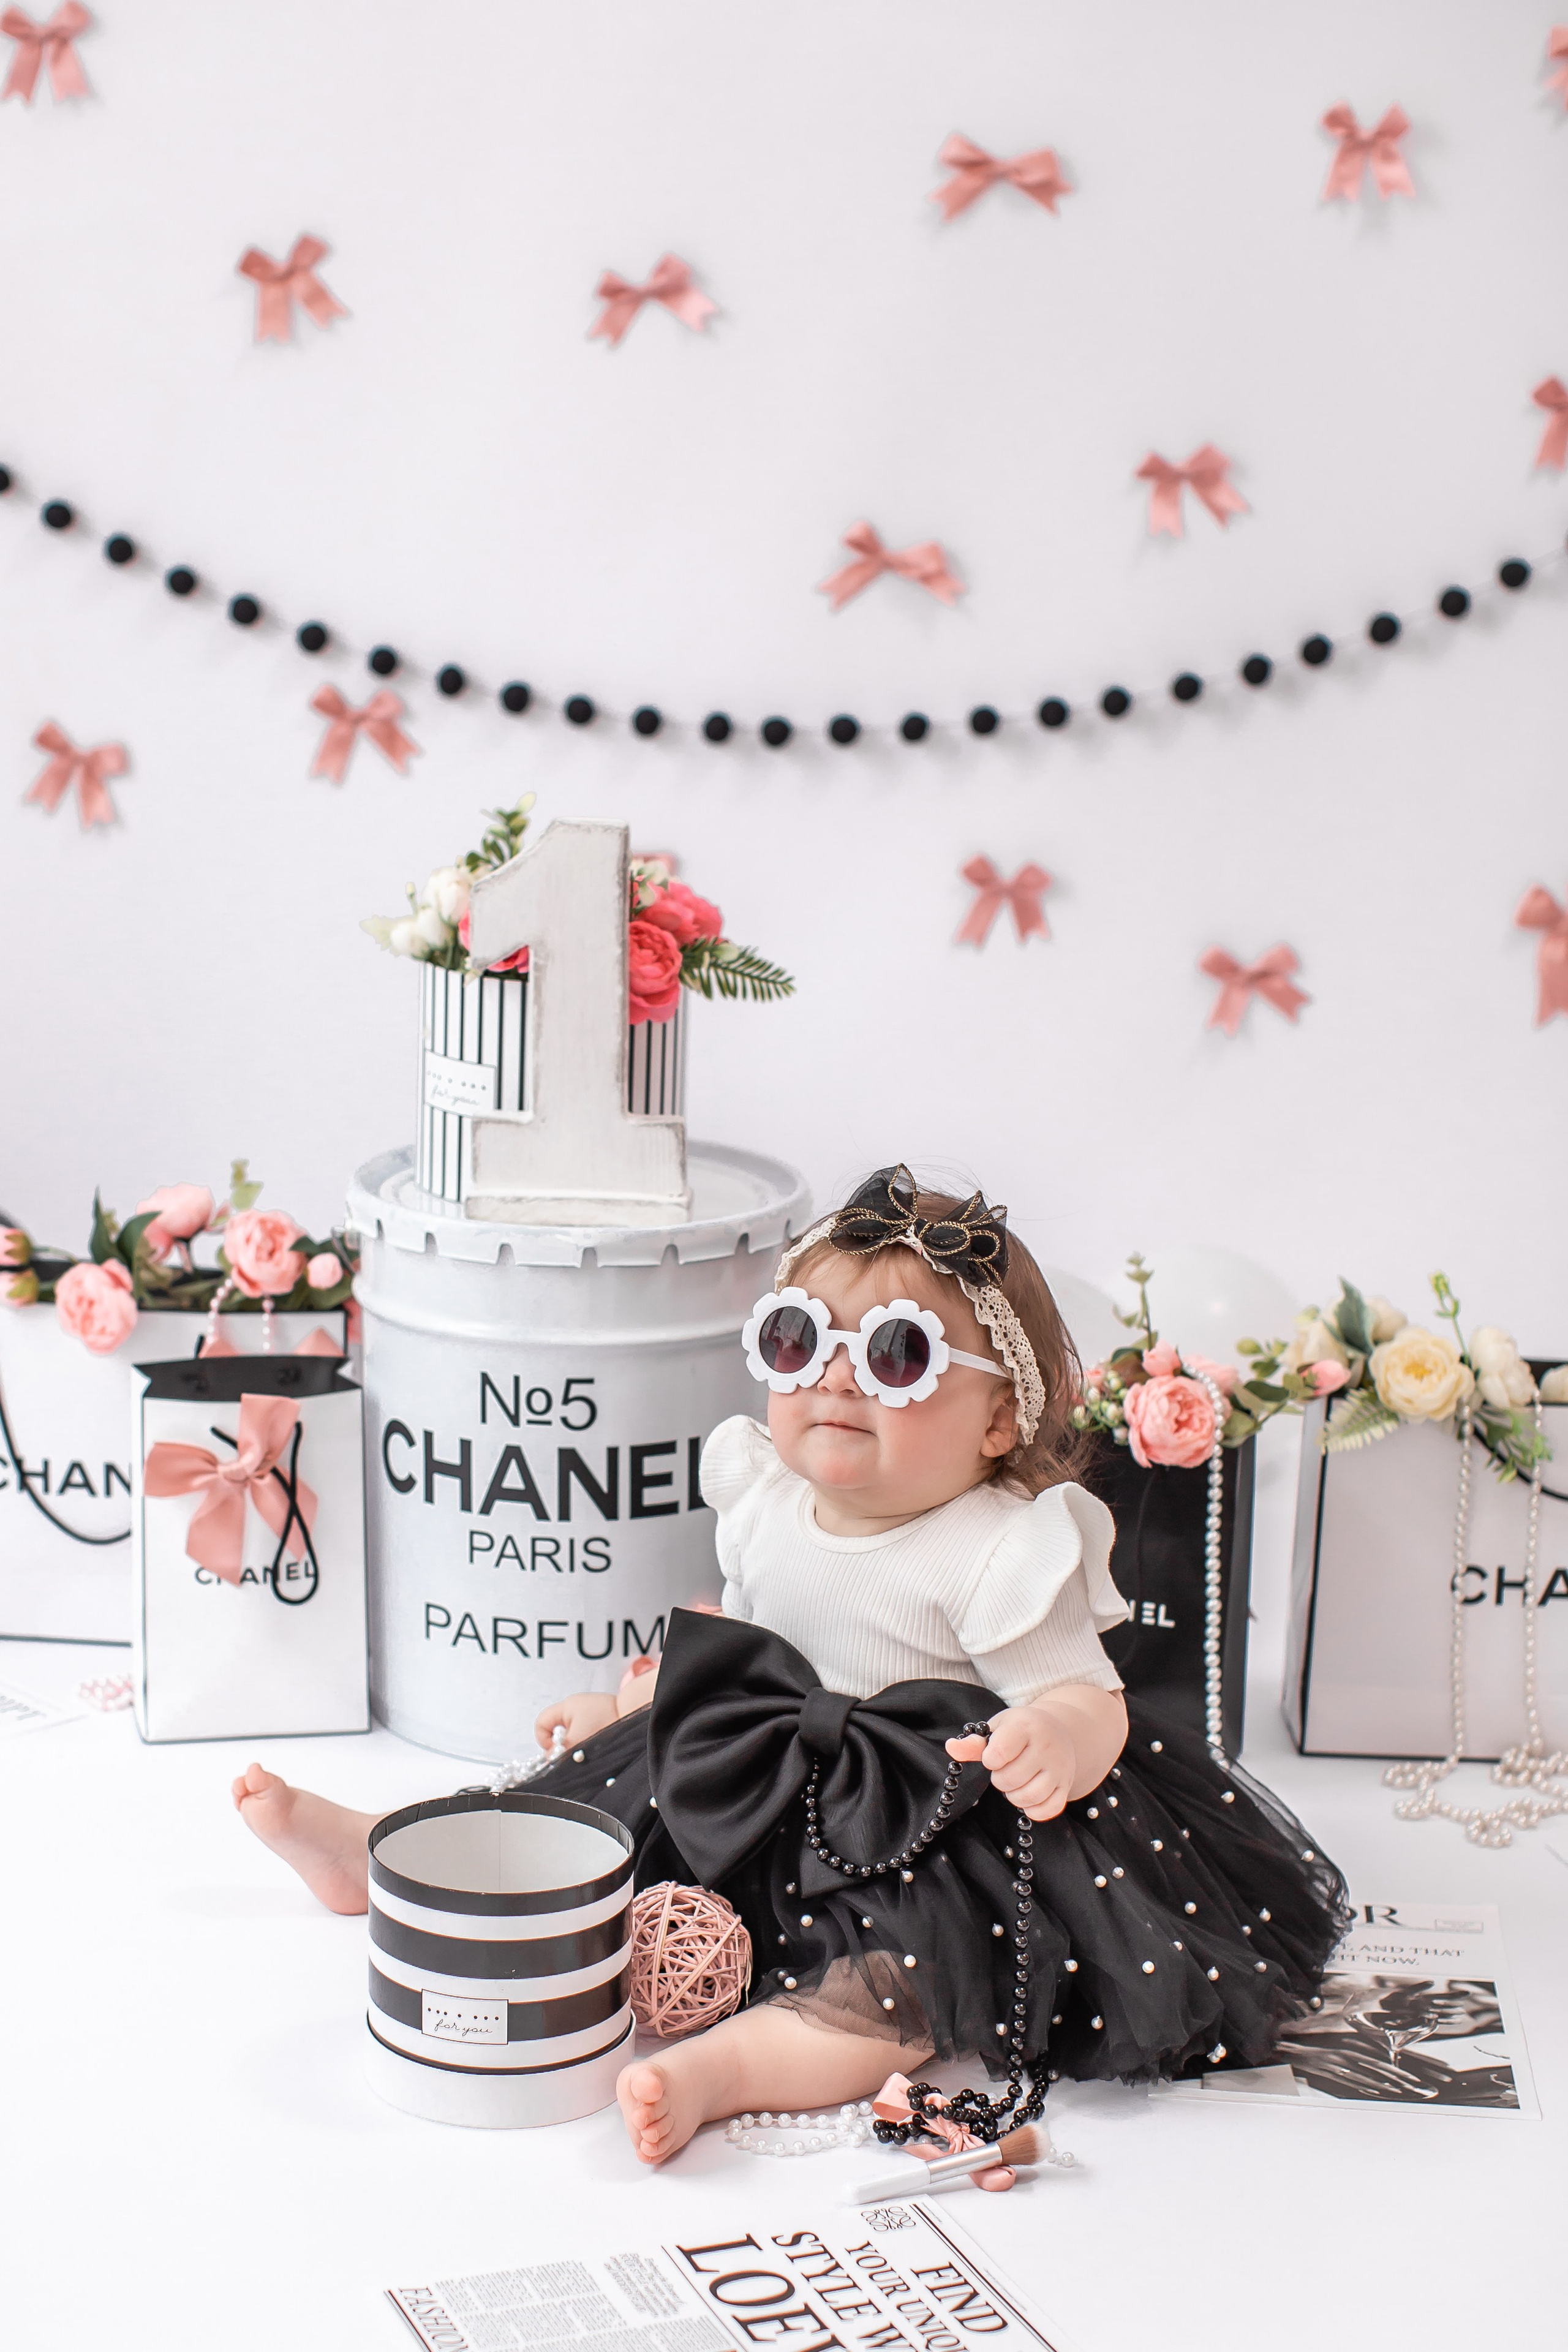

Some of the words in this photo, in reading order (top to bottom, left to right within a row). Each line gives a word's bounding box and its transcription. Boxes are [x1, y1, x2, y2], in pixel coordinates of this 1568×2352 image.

[466, 817, 692, 1226] 1
[0, 1456, 131, 1497] HAN
[468, 1529, 612, 1574] PARIS
[424, 1602, 666, 1661] PARFUM
[1360, 1943, 1404, 1953] AND
[1411, 1947, 1464, 1957] THAT
[434, 2019, 460, 2032] for
[462, 2027, 492, 2036] you
[771, 2231, 883, 2321] STYLE
[844, 2239, 911, 2298] YOUR
[910, 2261, 1009, 2333] FIND
